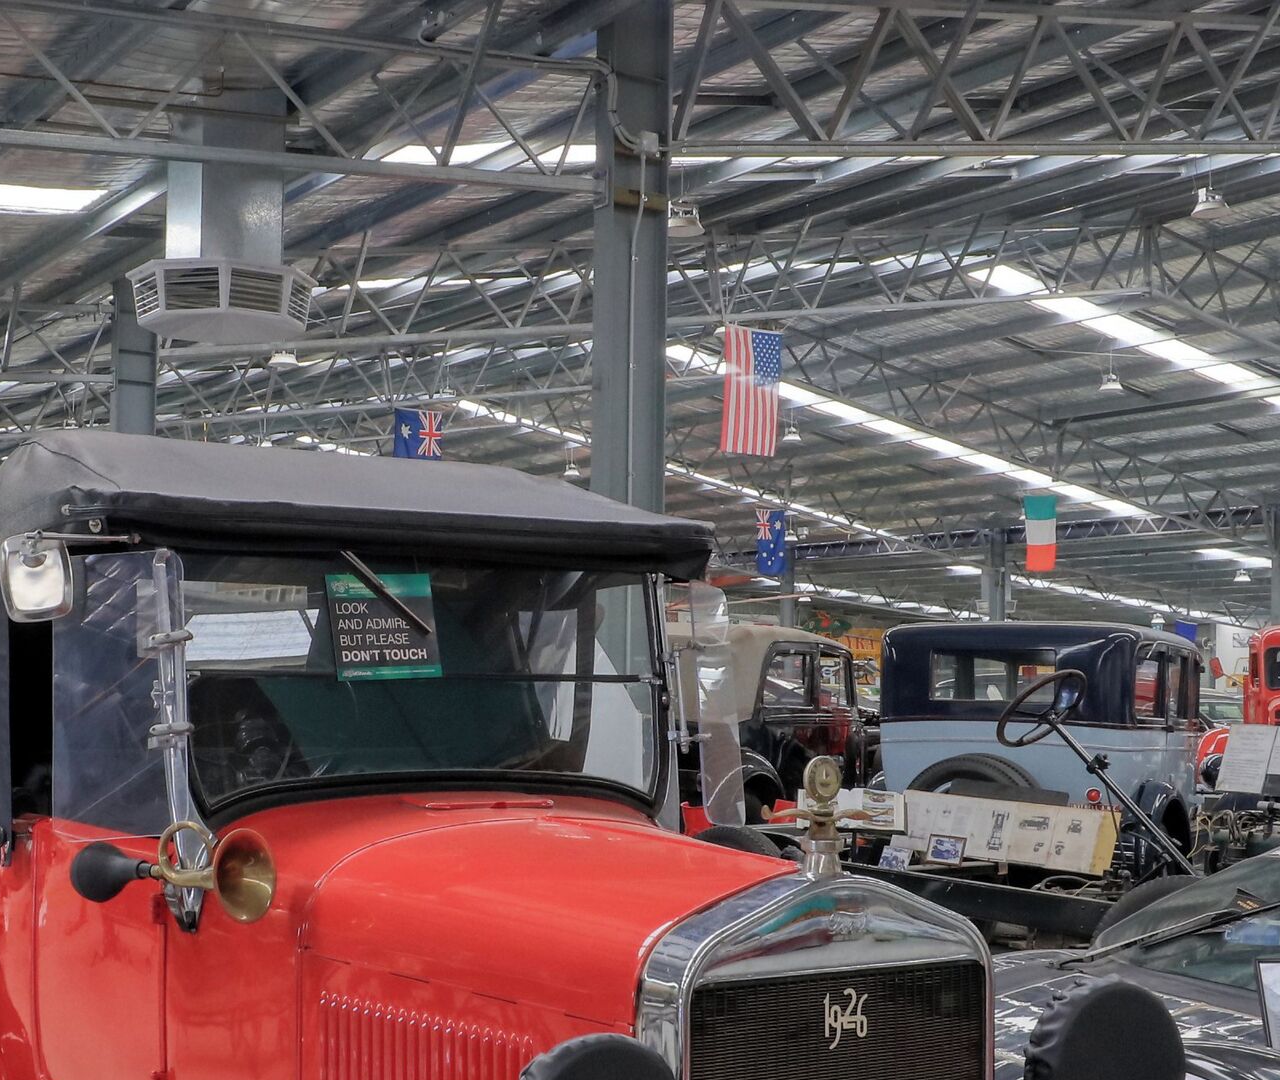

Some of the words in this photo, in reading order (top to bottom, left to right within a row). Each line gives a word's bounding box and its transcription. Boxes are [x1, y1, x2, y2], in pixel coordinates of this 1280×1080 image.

[335, 602, 369, 615] LOOK
[338, 618, 363, 630] AND
[365, 617, 410, 630] ADMIRE
[340, 634, 363, 646] BUT
[365, 633, 410, 646] PLEASE
[342, 649, 381, 662] DON'T
[383, 648, 428, 661] TOUCH
[823, 987, 869, 1050] 1926
